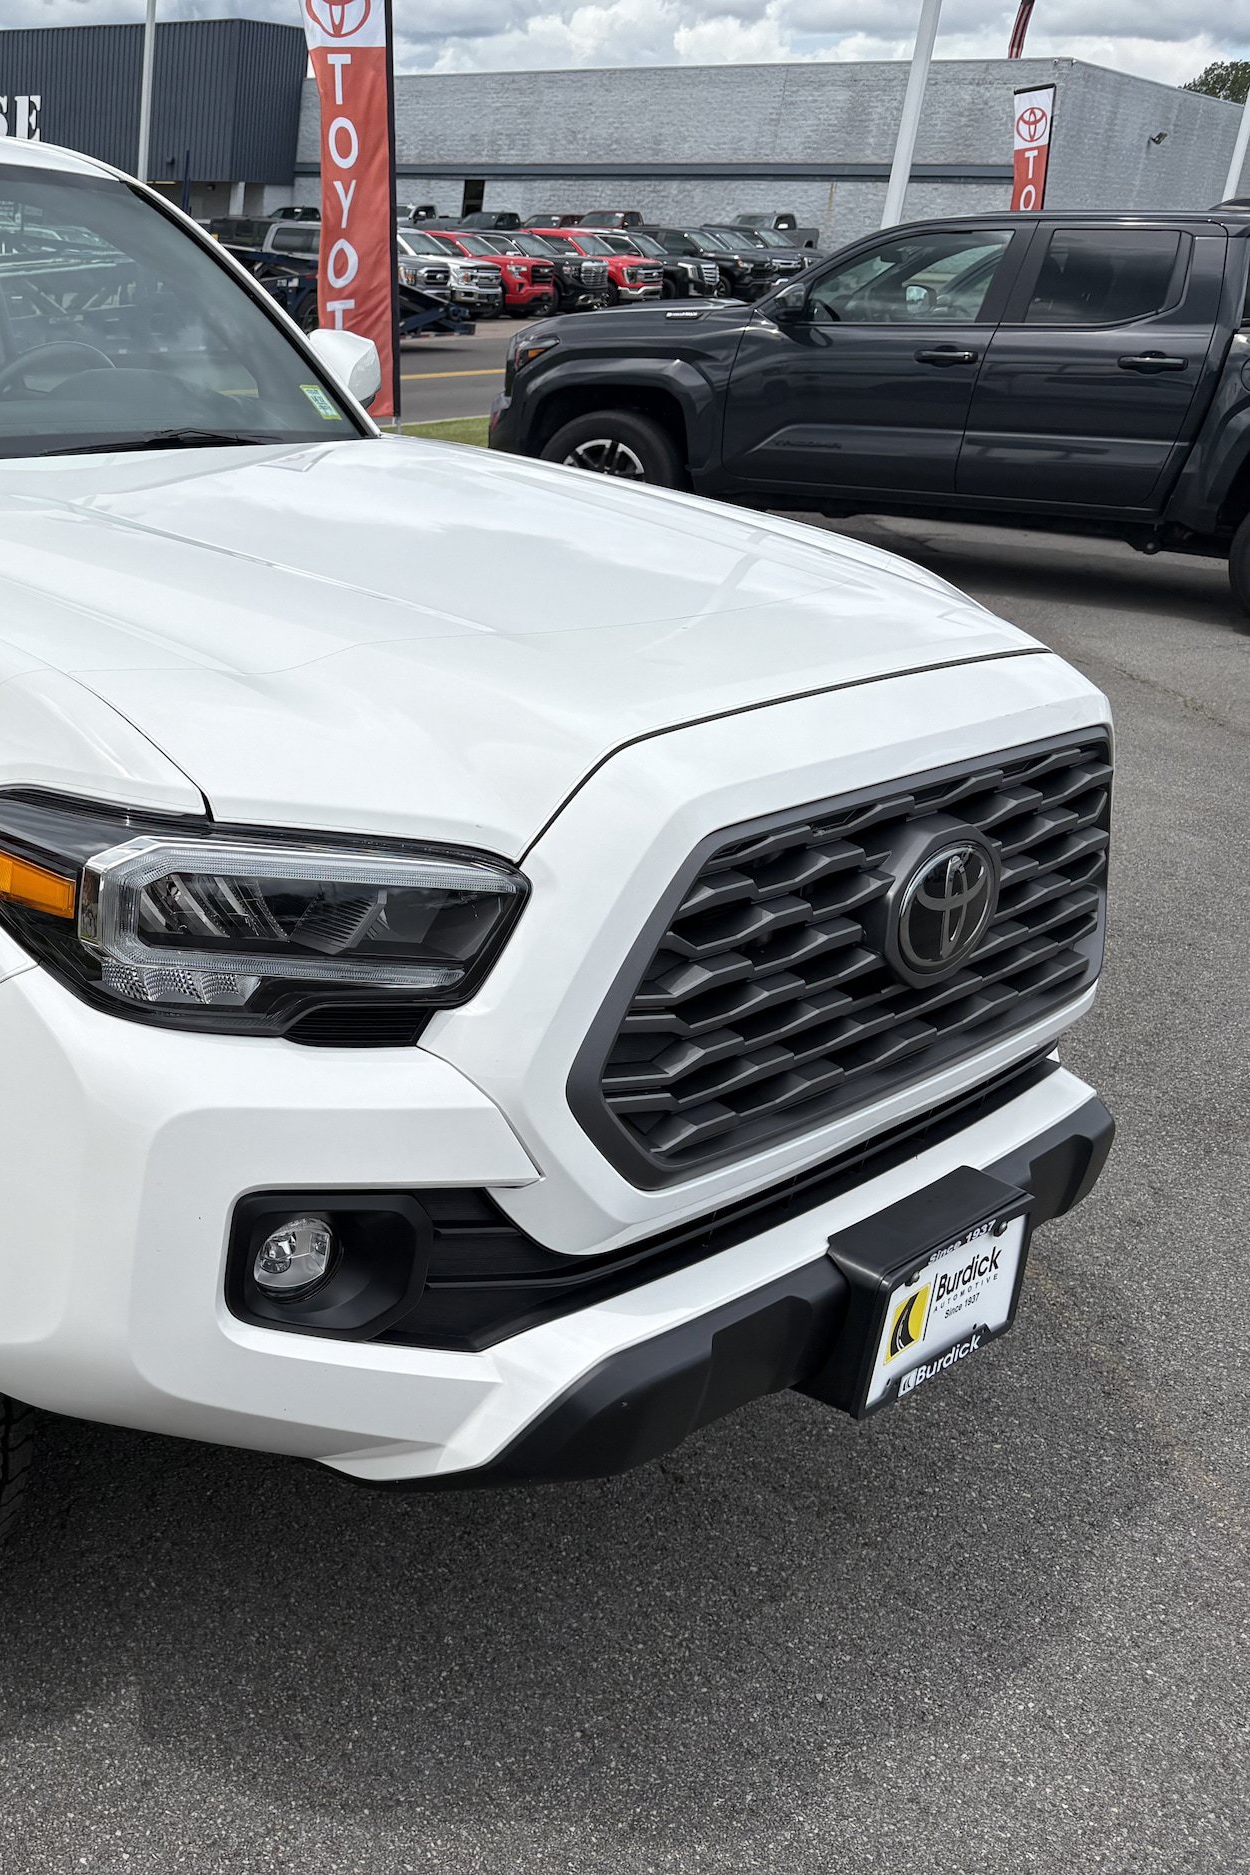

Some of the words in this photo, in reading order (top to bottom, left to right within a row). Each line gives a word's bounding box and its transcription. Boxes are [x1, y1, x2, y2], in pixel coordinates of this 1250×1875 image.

[325, 53, 359, 331] TOYOT
[965, 1219, 997, 1243] 1937
[933, 1273, 998, 1313] AUTOMOTIVE
[936, 1246, 1002, 1302] Burdick
[944, 1303, 963, 1319] Since
[964, 1292, 980, 1308] 1937
[915, 1335, 981, 1386] Burdick
